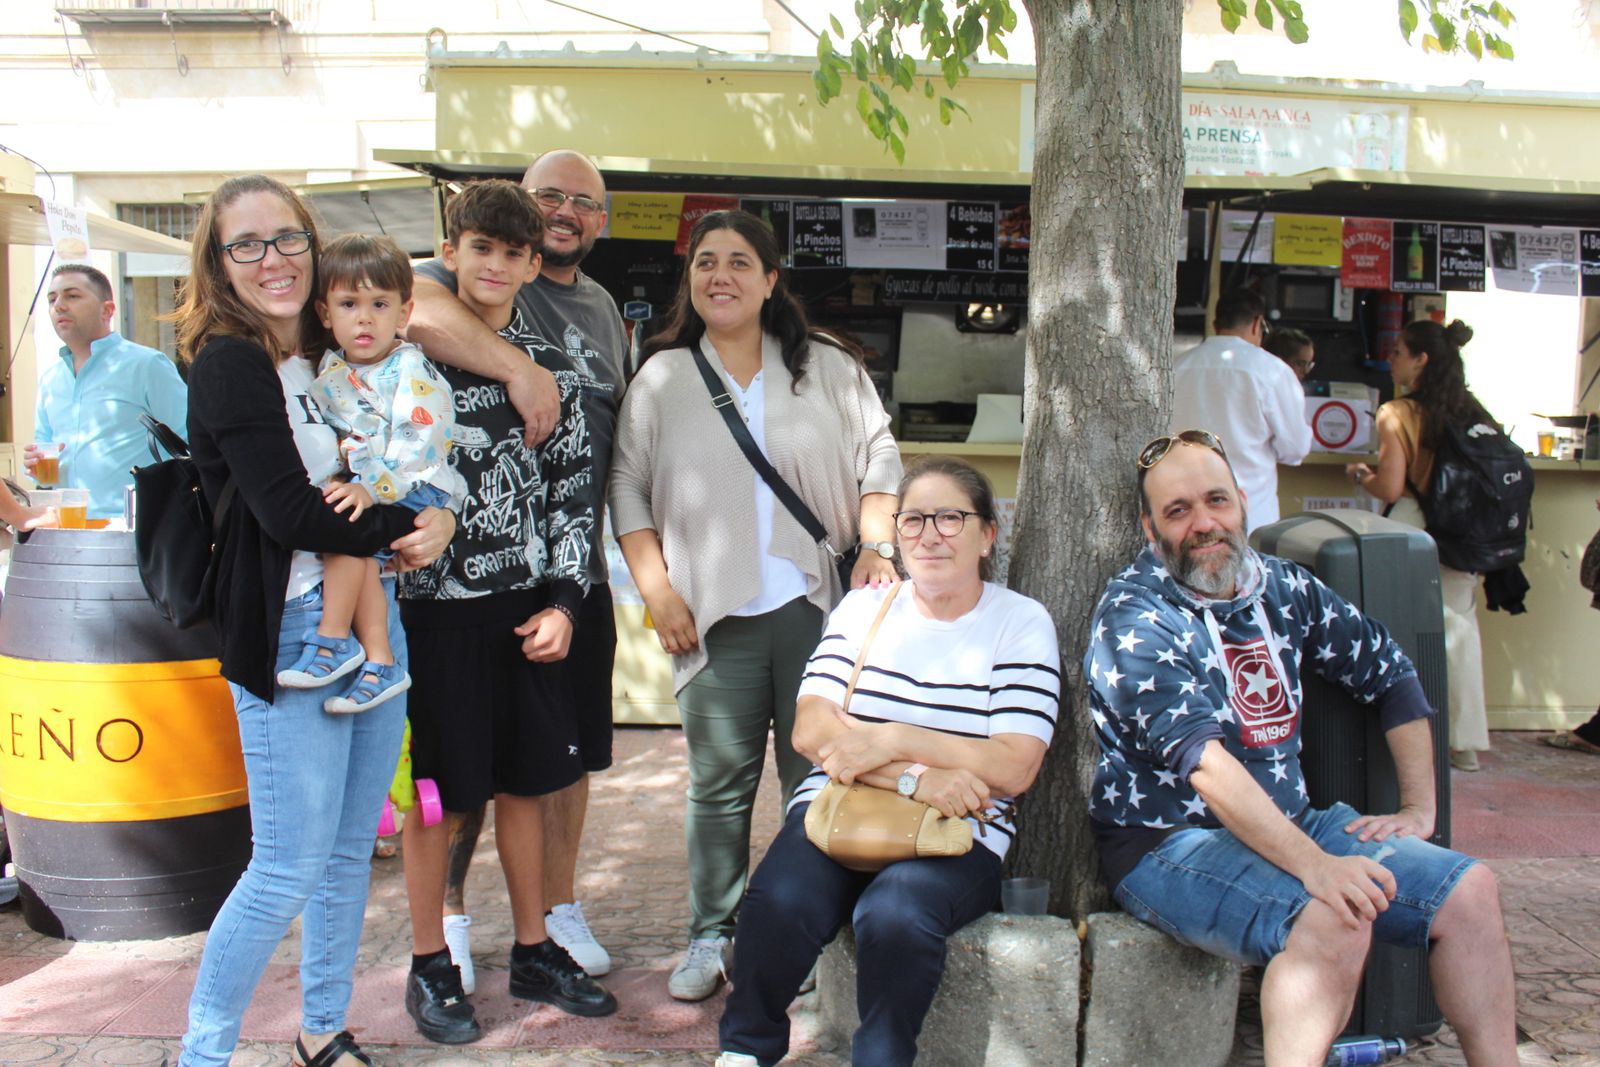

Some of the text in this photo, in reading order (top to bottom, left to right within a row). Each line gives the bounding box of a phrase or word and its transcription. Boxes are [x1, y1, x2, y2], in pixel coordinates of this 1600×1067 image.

[1197, 127, 1262, 144] PRENSA
[949, 206, 994, 224] 4 Bebidas
[795, 233, 841, 246] 4 Pinchos
[1441, 257, 1484, 270] 4 Pinchos
[0, 707, 144, 763] EÑO
